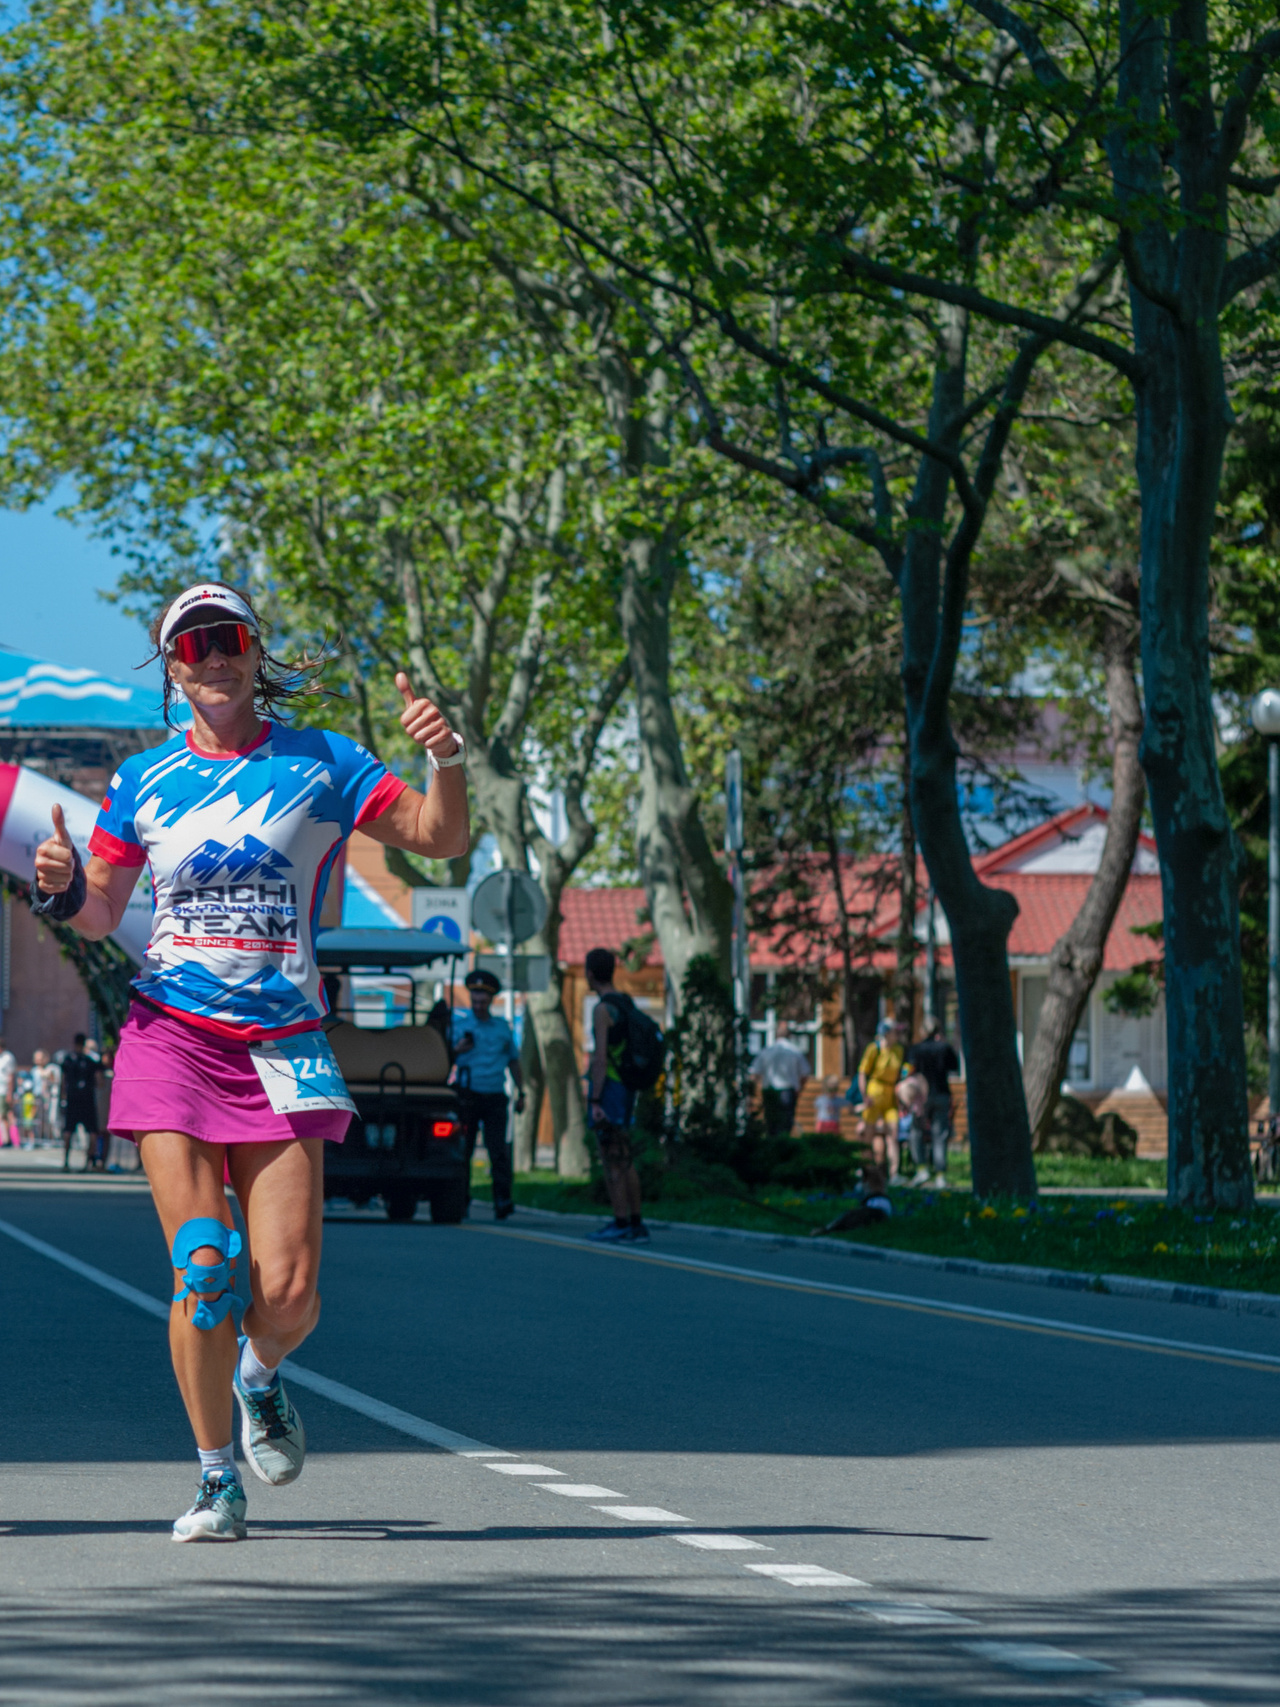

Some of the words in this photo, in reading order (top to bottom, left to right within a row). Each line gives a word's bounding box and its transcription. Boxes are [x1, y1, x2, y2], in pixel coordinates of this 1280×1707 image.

[172, 904, 297, 917] SKYRUNNING
[174, 914, 297, 939] TEAM
[194, 938, 236, 947] SINCE
[243, 941, 274, 950] 2014
[293, 1053, 342, 1080] 245
